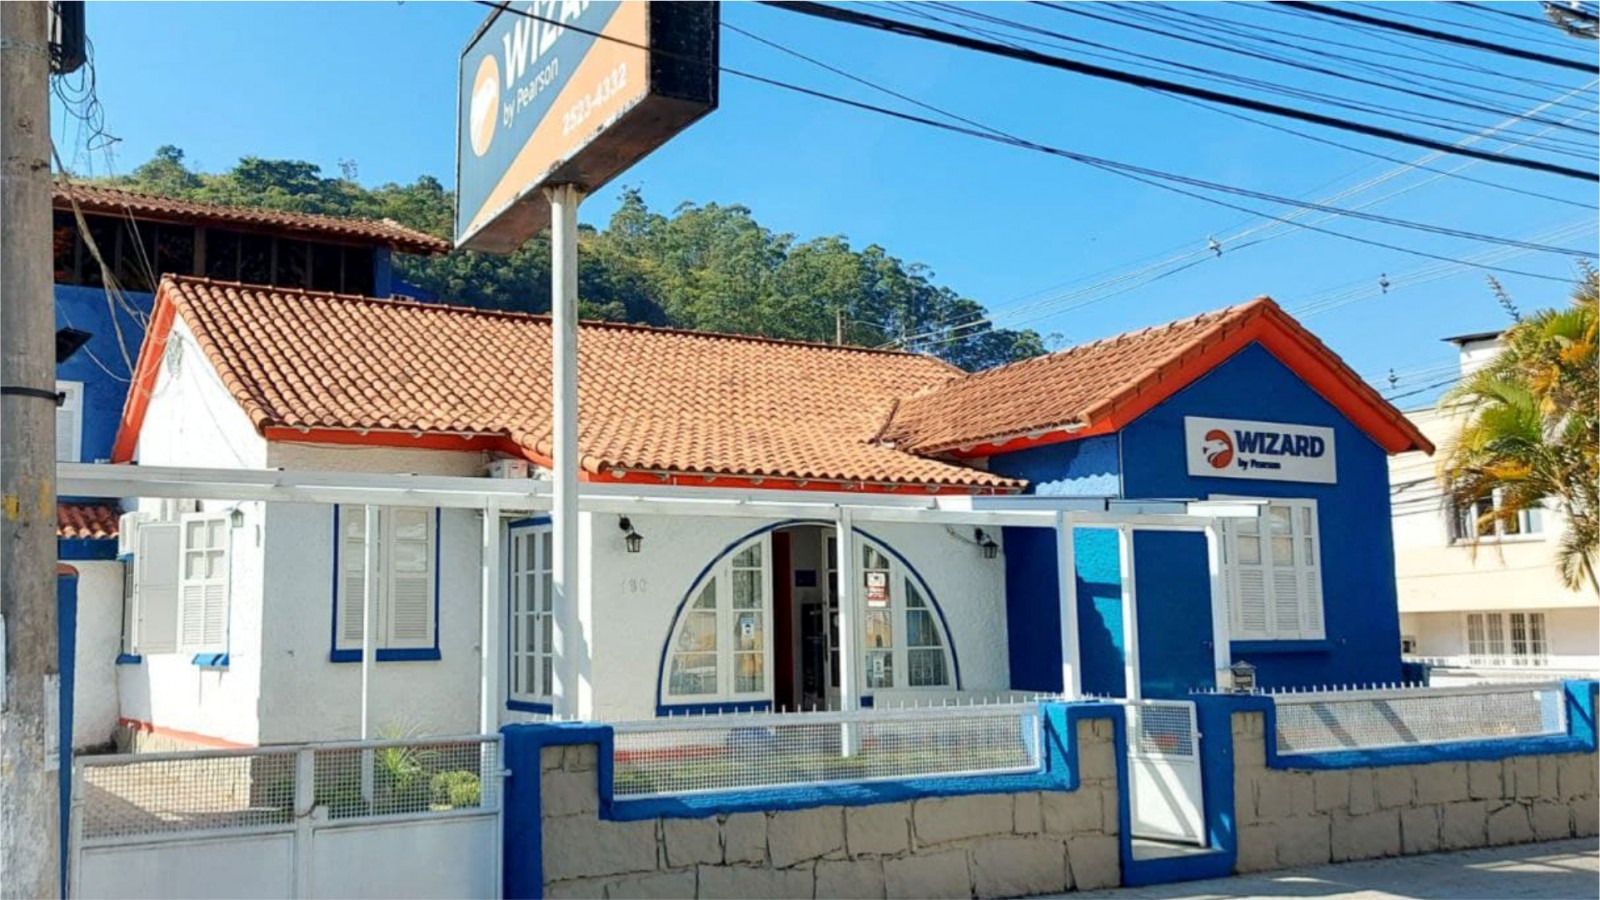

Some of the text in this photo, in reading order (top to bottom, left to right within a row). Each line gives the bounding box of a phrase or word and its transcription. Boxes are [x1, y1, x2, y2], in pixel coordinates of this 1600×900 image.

[503, 1, 589, 91] WIZA
[502, 57, 559, 128] by Pearson
[1235, 431, 1325, 458] WIZARD
[1238, 458, 1248, 470] by
